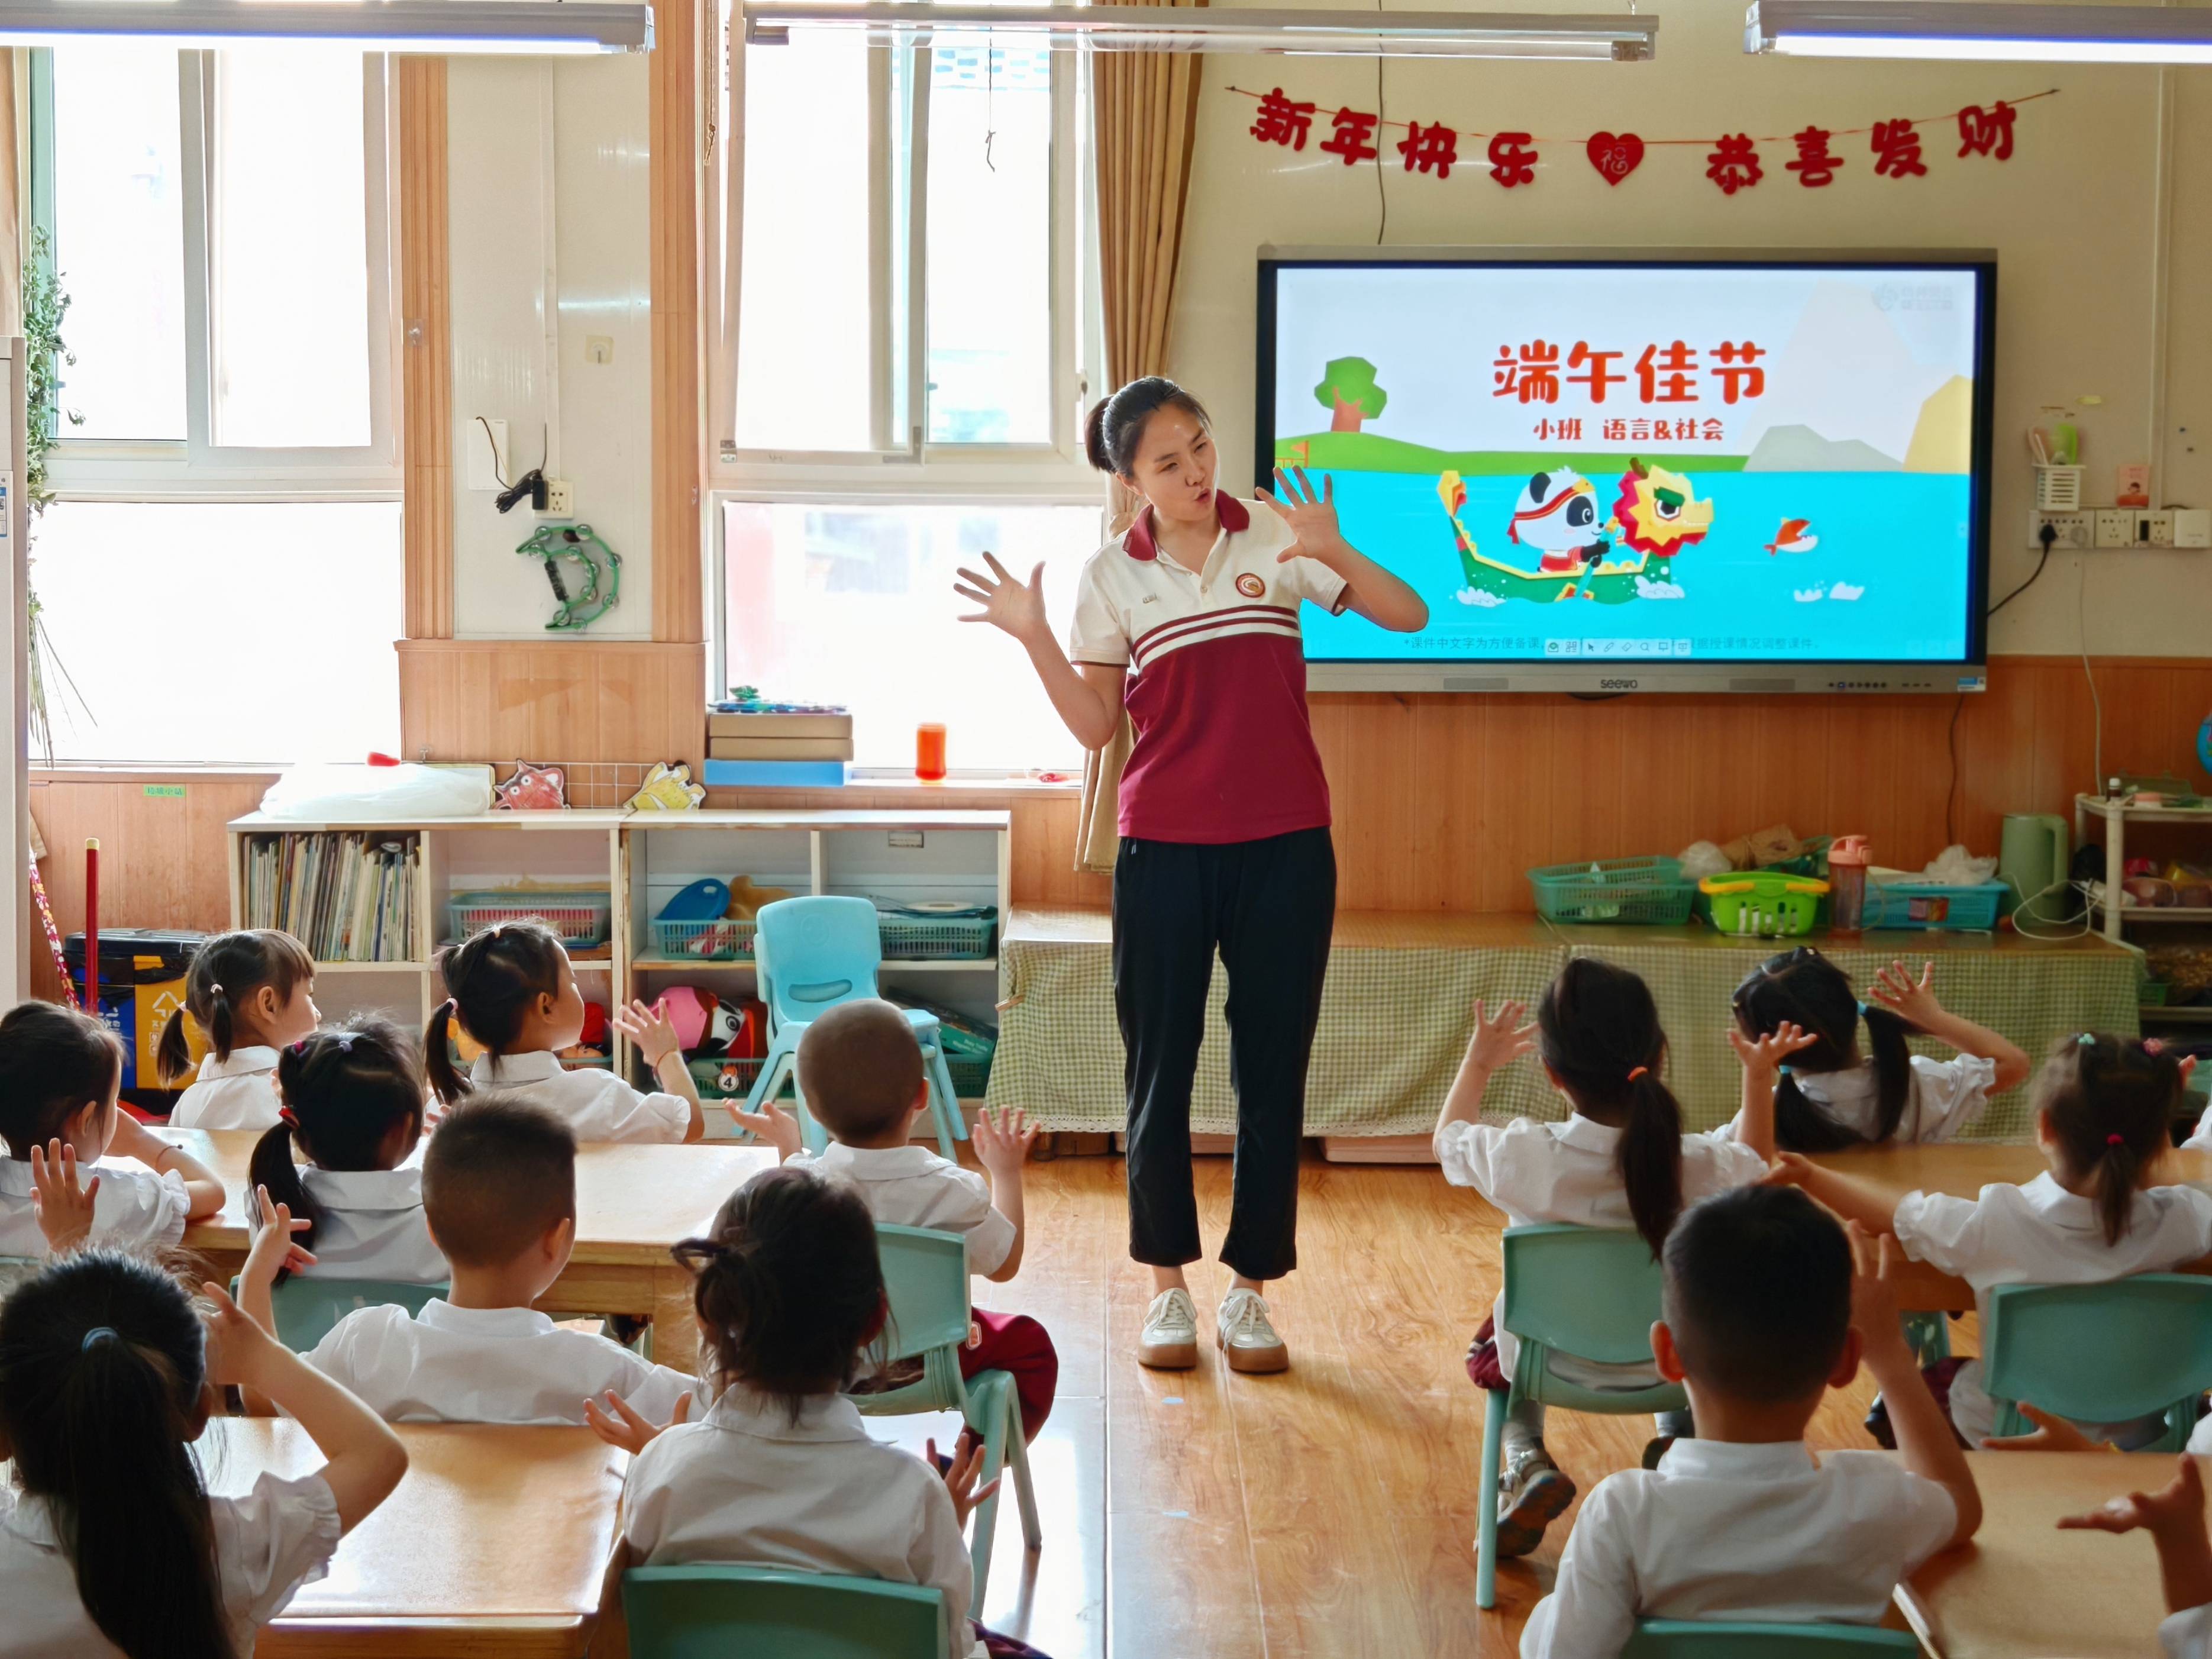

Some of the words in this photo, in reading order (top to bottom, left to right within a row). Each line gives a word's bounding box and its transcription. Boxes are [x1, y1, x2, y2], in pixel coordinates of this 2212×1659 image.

[1249, 87, 1538, 188] 新年快乐
[1706, 100, 2017, 195] 恭喜发财
[1493, 339, 1766, 405] 端午佳节
[1533, 418, 1583, 441] 小班
[1602, 418, 1725, 441] 语言&社会
[723, 1076, 734, 1089] 4
